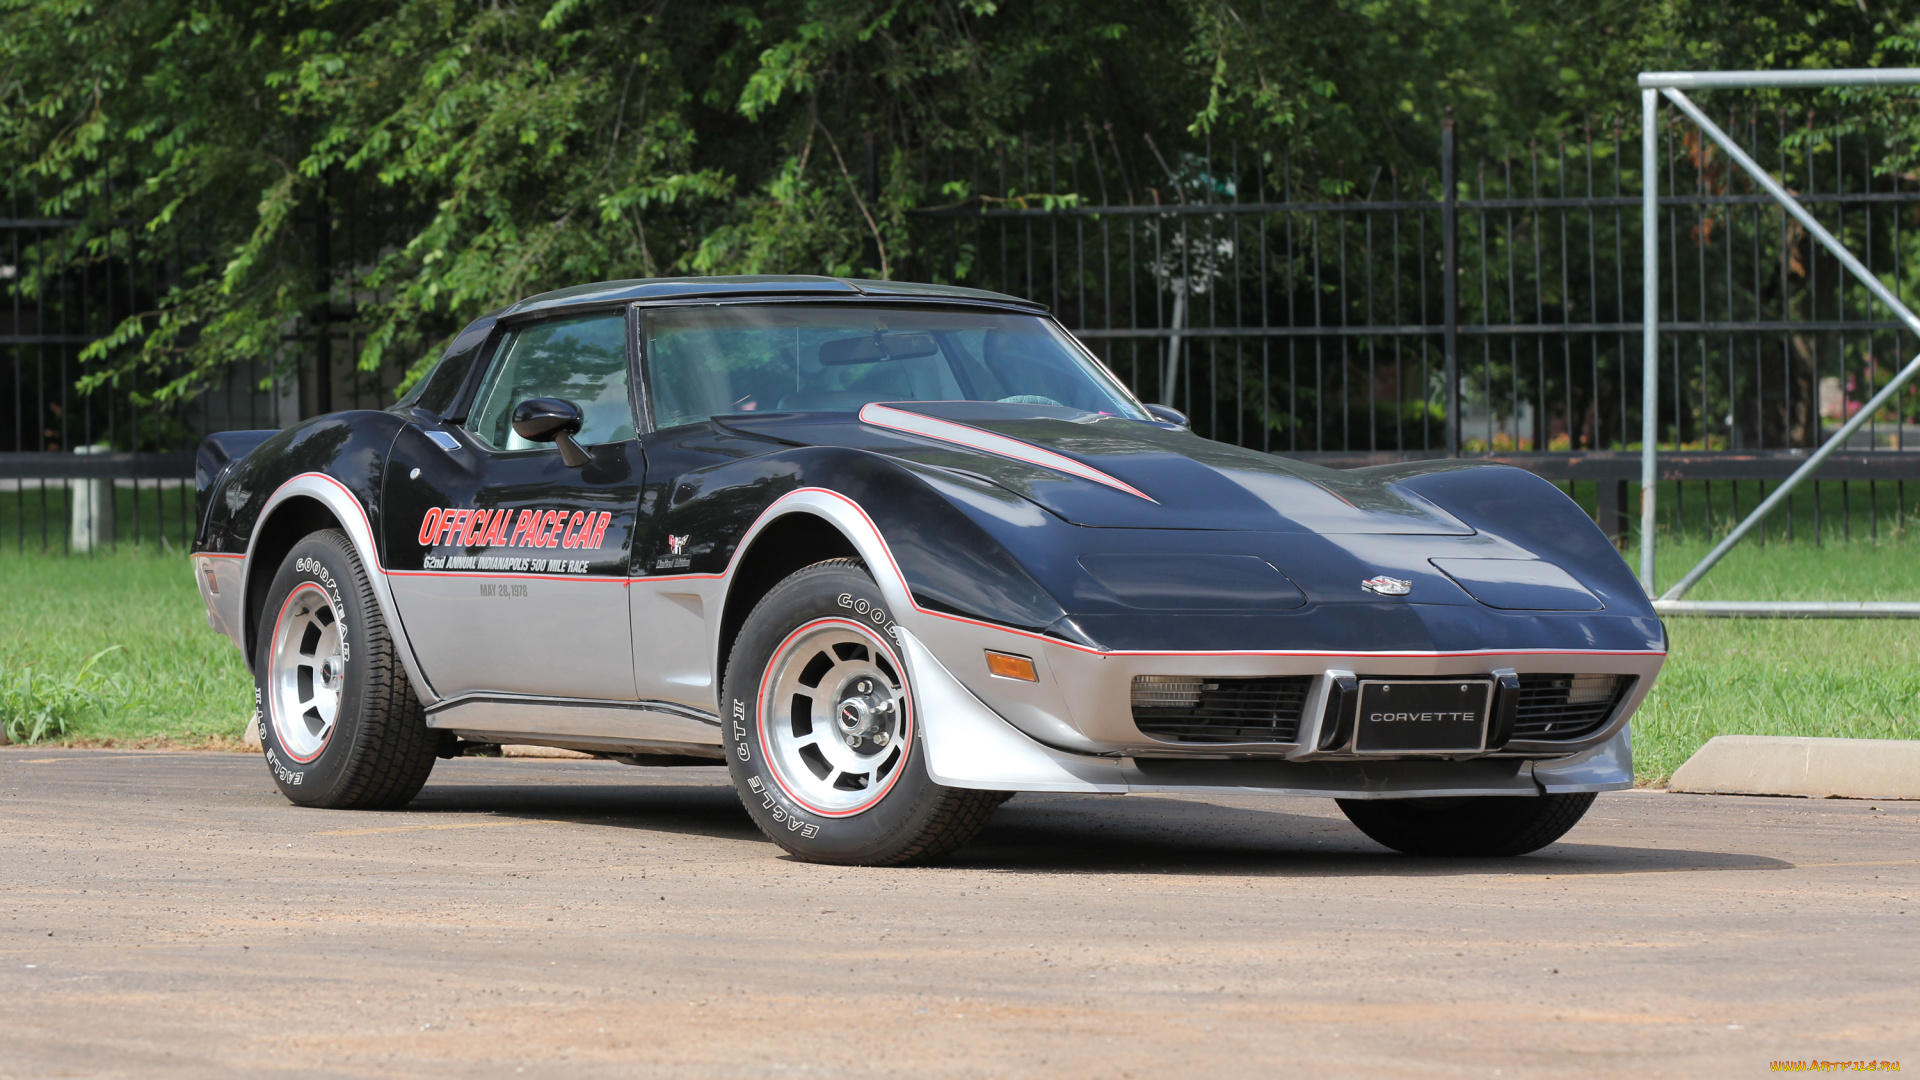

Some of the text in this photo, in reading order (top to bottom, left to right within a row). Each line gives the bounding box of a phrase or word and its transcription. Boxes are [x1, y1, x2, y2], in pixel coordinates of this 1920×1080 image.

[418, 507, 612, 550] OFFICIAL PACE CAR
[423, 555, 589, 573] 62nd ANNUAL INDIANAPOLIS 500 MILE RACE
[480, 584, 496, 597] MAY
[1370, 712, 1475, 722] CORVETTE
[266, 747, 304, 786] EAGLE
[747, 775, 820, 840] EAGLE
